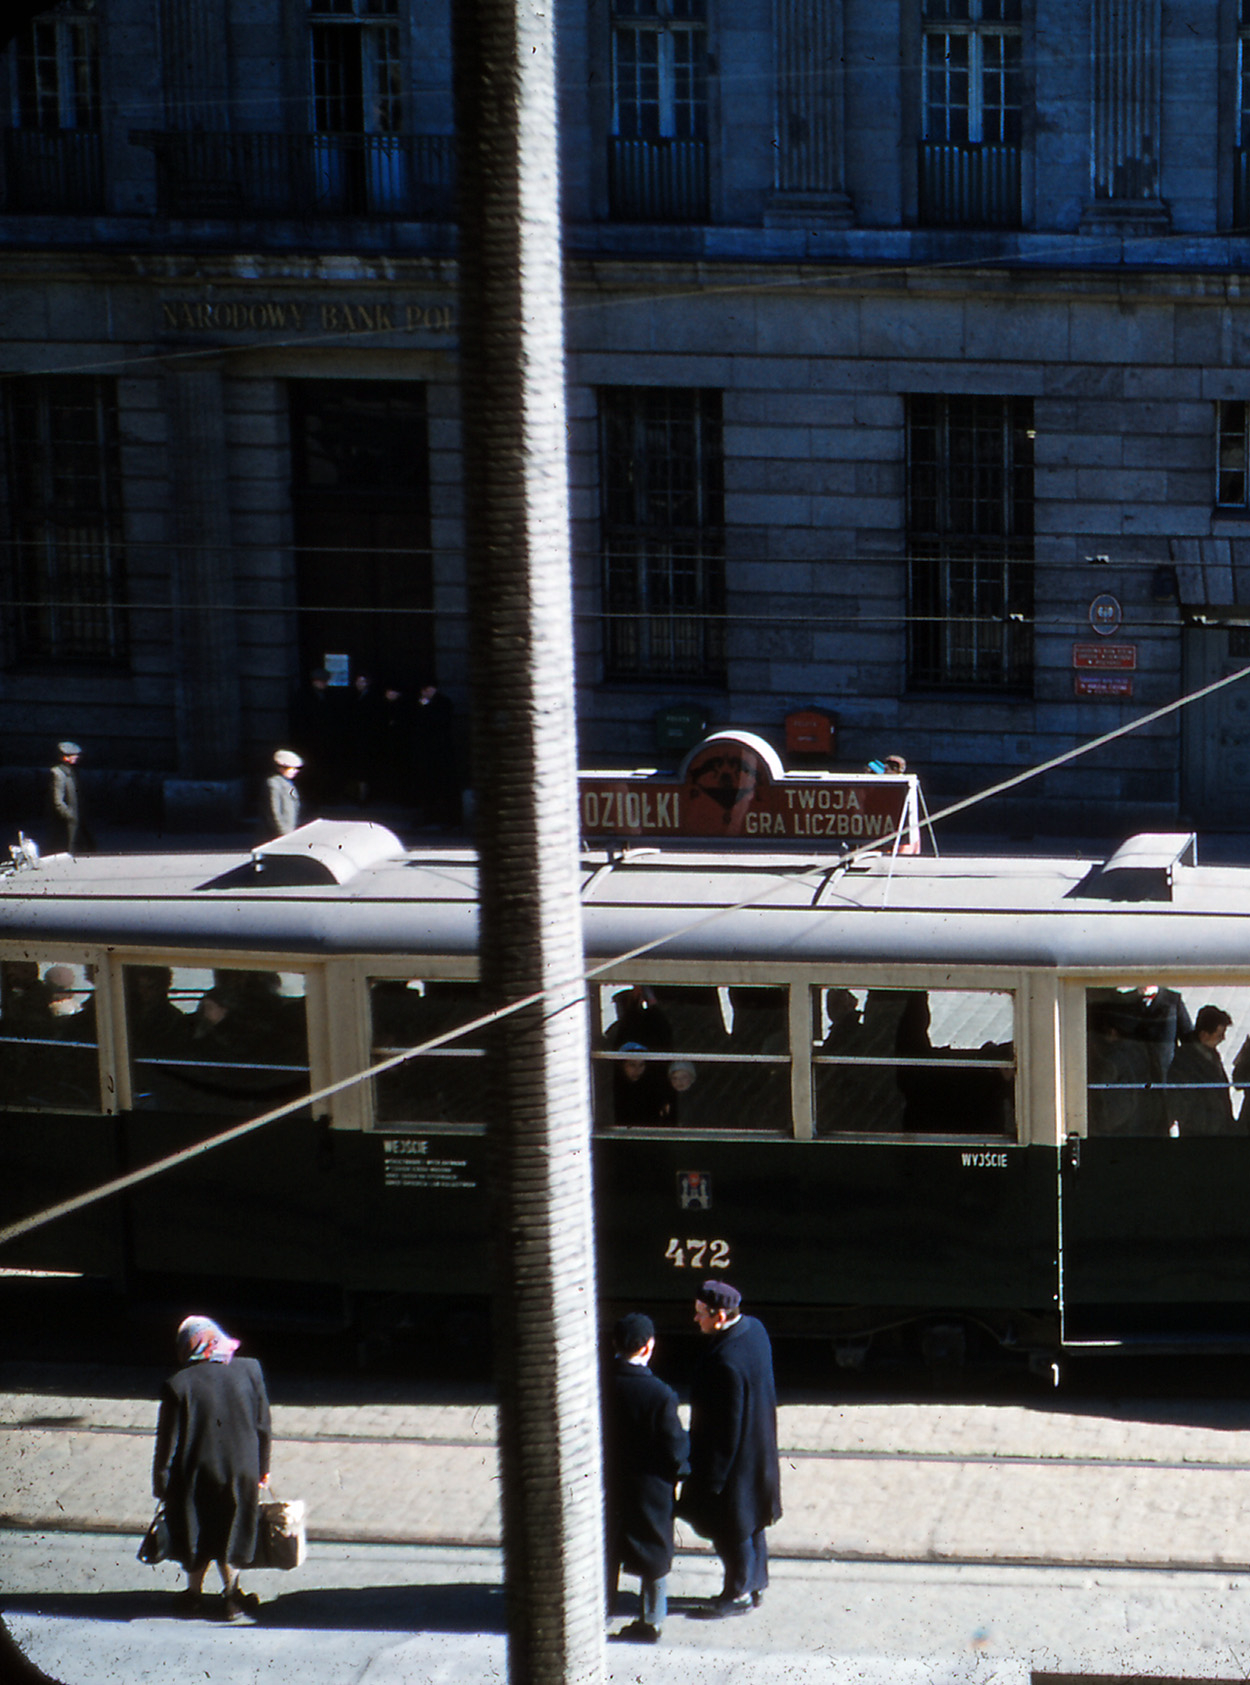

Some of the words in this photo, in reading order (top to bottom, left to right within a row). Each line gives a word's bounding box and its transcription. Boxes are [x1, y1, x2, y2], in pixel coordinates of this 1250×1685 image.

[162, 303, 306, 329] NARODOWY
[321, 304, 395, 330] BANK
[405, 305, 453, 332] POL
[582, 791, 680, 828] OZIOŁKI
[784, 789, 860, 810] TWOJA
[745, 812, 787, 835] GRA
[794, 812, 896, 836] LICZBOWA
[961, 1151, 1008, 1168] WYJŚCIE
[664, 1238, 731, 1269] 472
